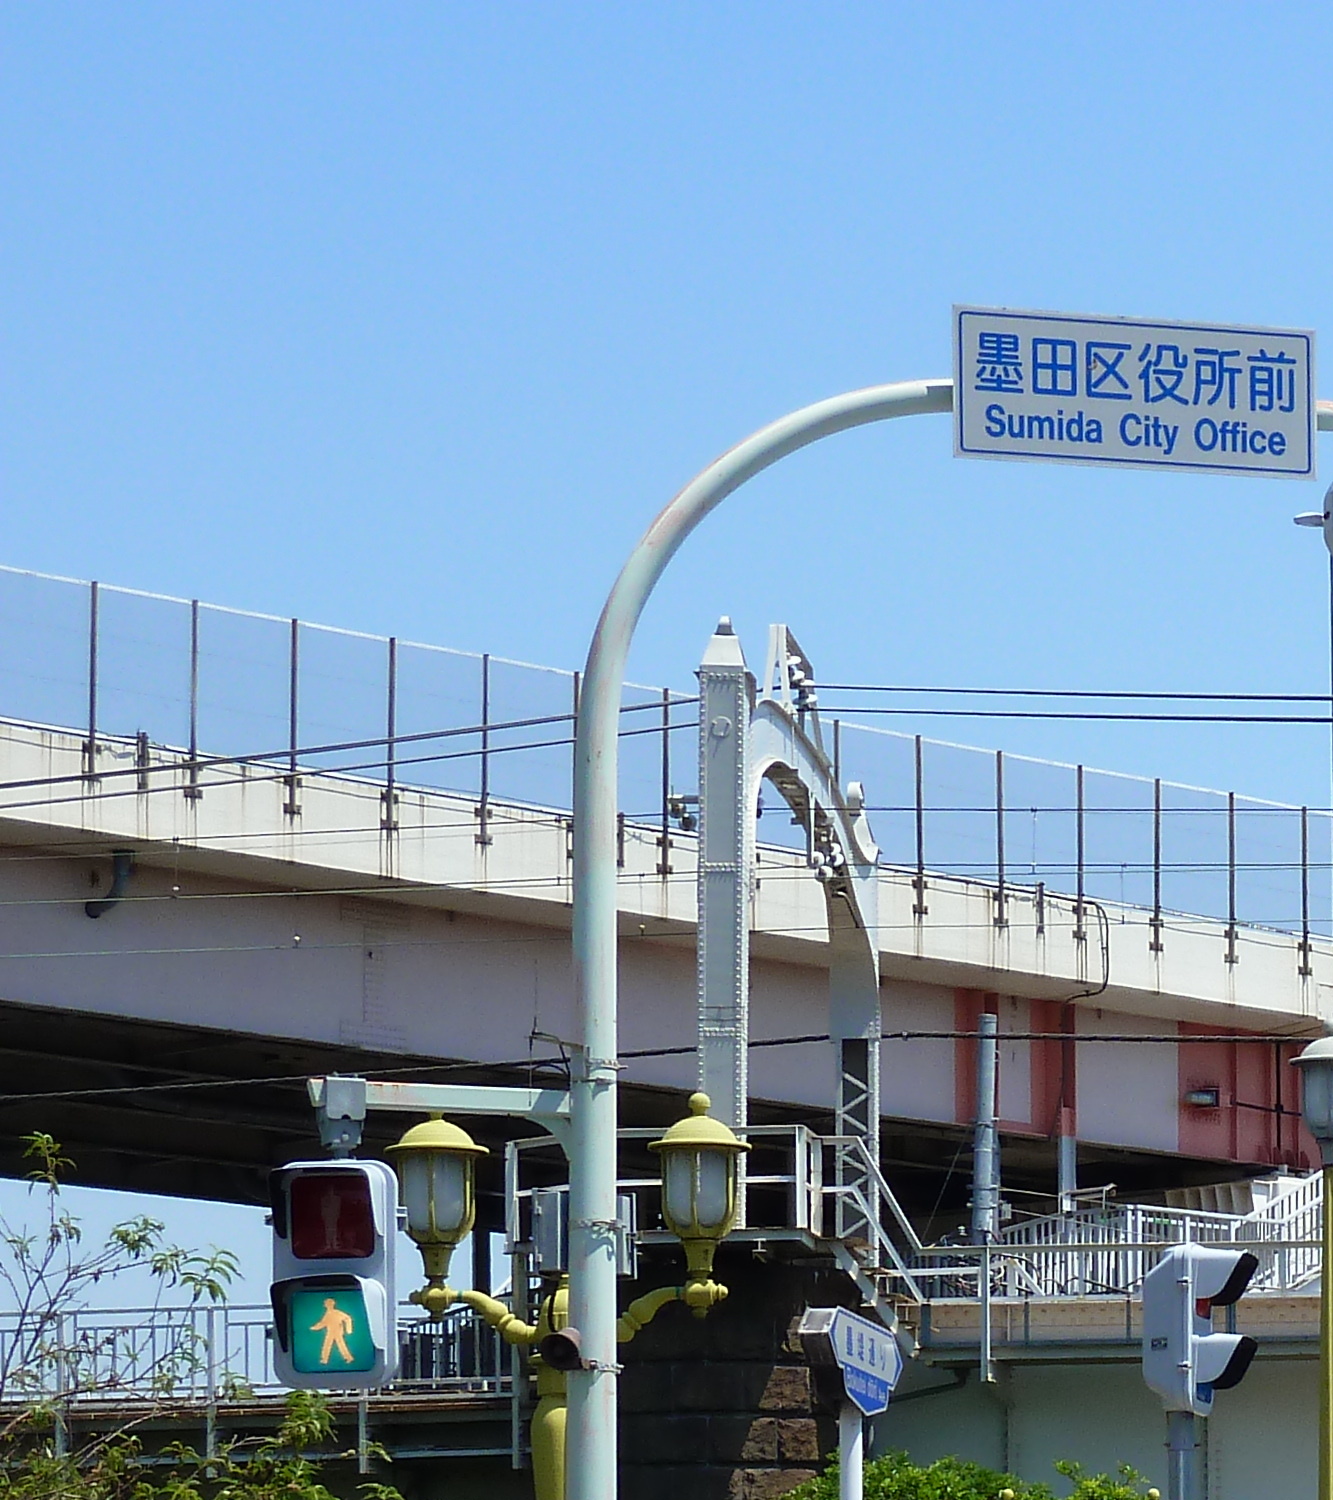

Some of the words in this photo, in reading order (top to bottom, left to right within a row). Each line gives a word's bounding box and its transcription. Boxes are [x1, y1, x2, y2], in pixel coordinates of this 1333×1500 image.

[975, 332, 1296, 412] 墨田区役所前
[985, 404, 1102, 443] Sumida
[1119, 413, 1179, 455] City
[1194, 417, 1287, 456] Office
